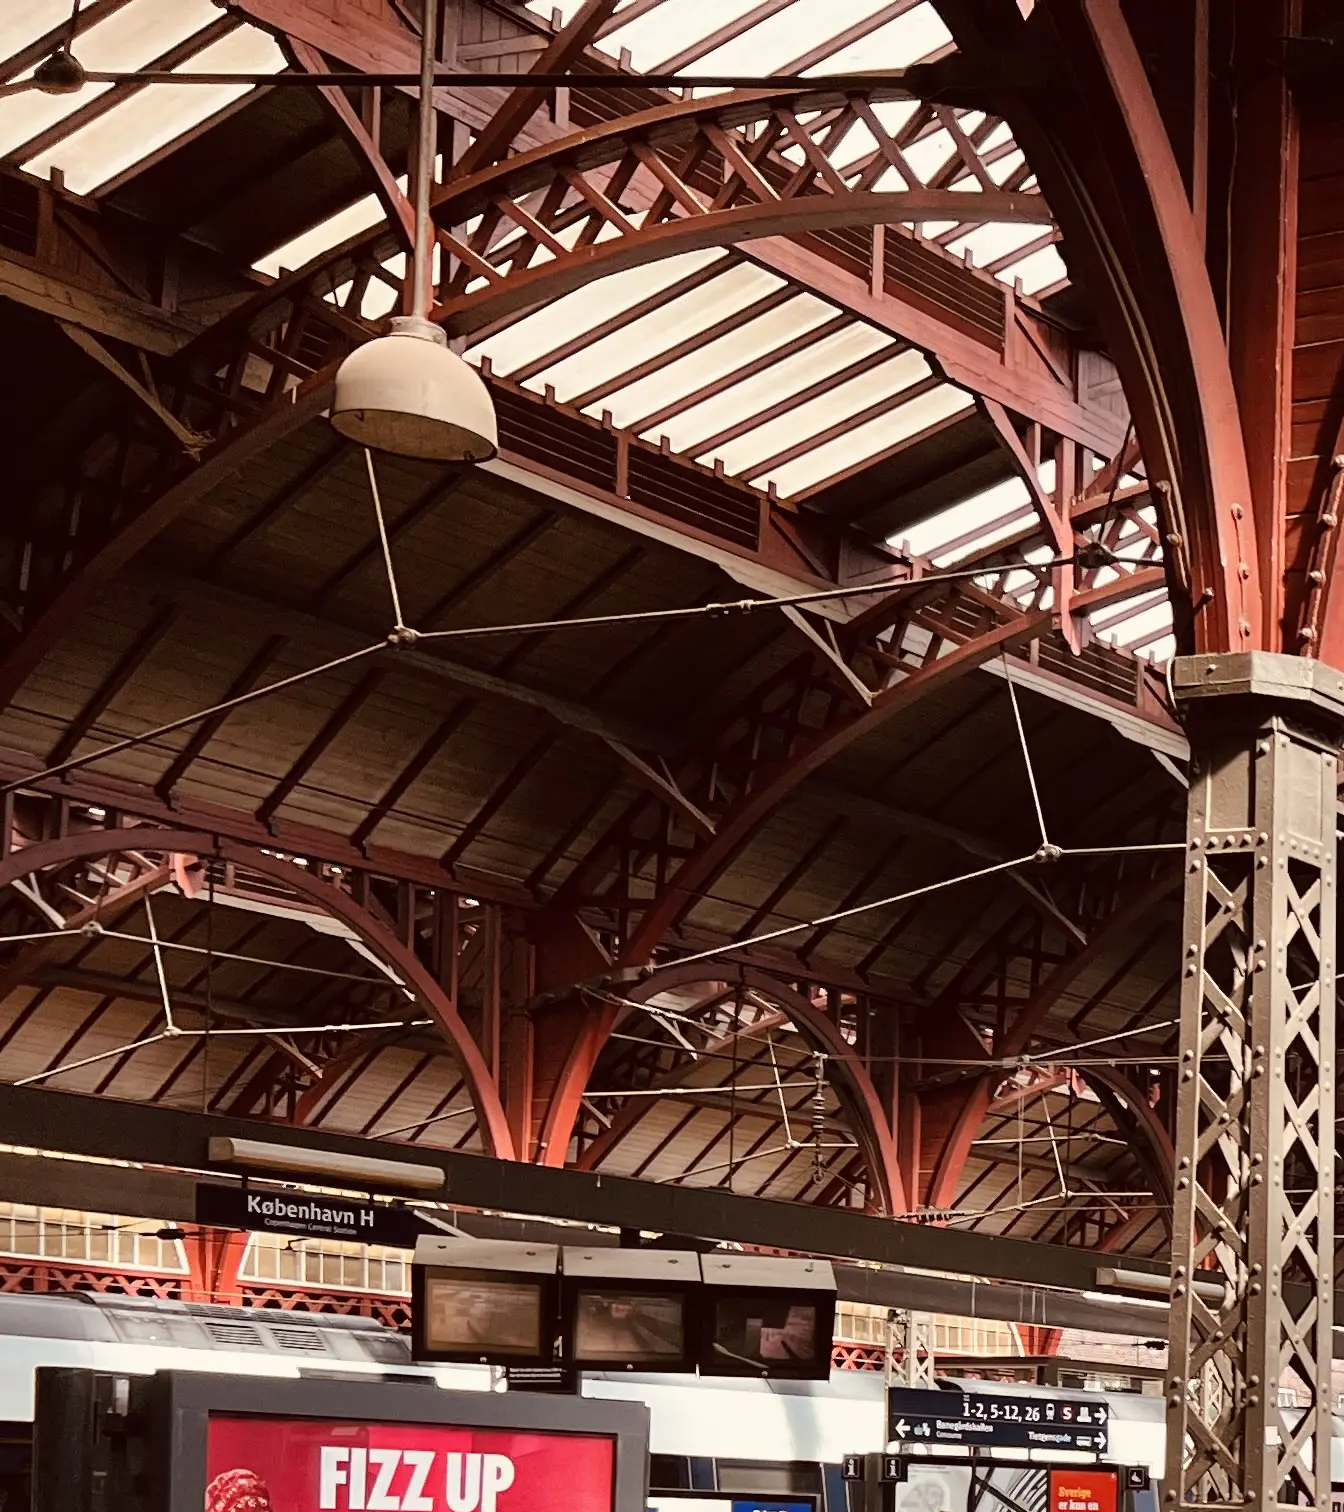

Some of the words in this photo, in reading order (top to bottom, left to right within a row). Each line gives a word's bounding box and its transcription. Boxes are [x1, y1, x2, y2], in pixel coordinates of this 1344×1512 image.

[247, 1195, 355, 1224] København
[360, 1209, 374, 1227] H
[962, 1402, 988, 1420] 1-2,
[990, 1404, 1023, 1422] 5-12,
[1025, 1406, 1041, 1422] 26
[319, 1446, 436, 1512] FIZZ
[1058, 1486, 1092, 1500] Sverige
